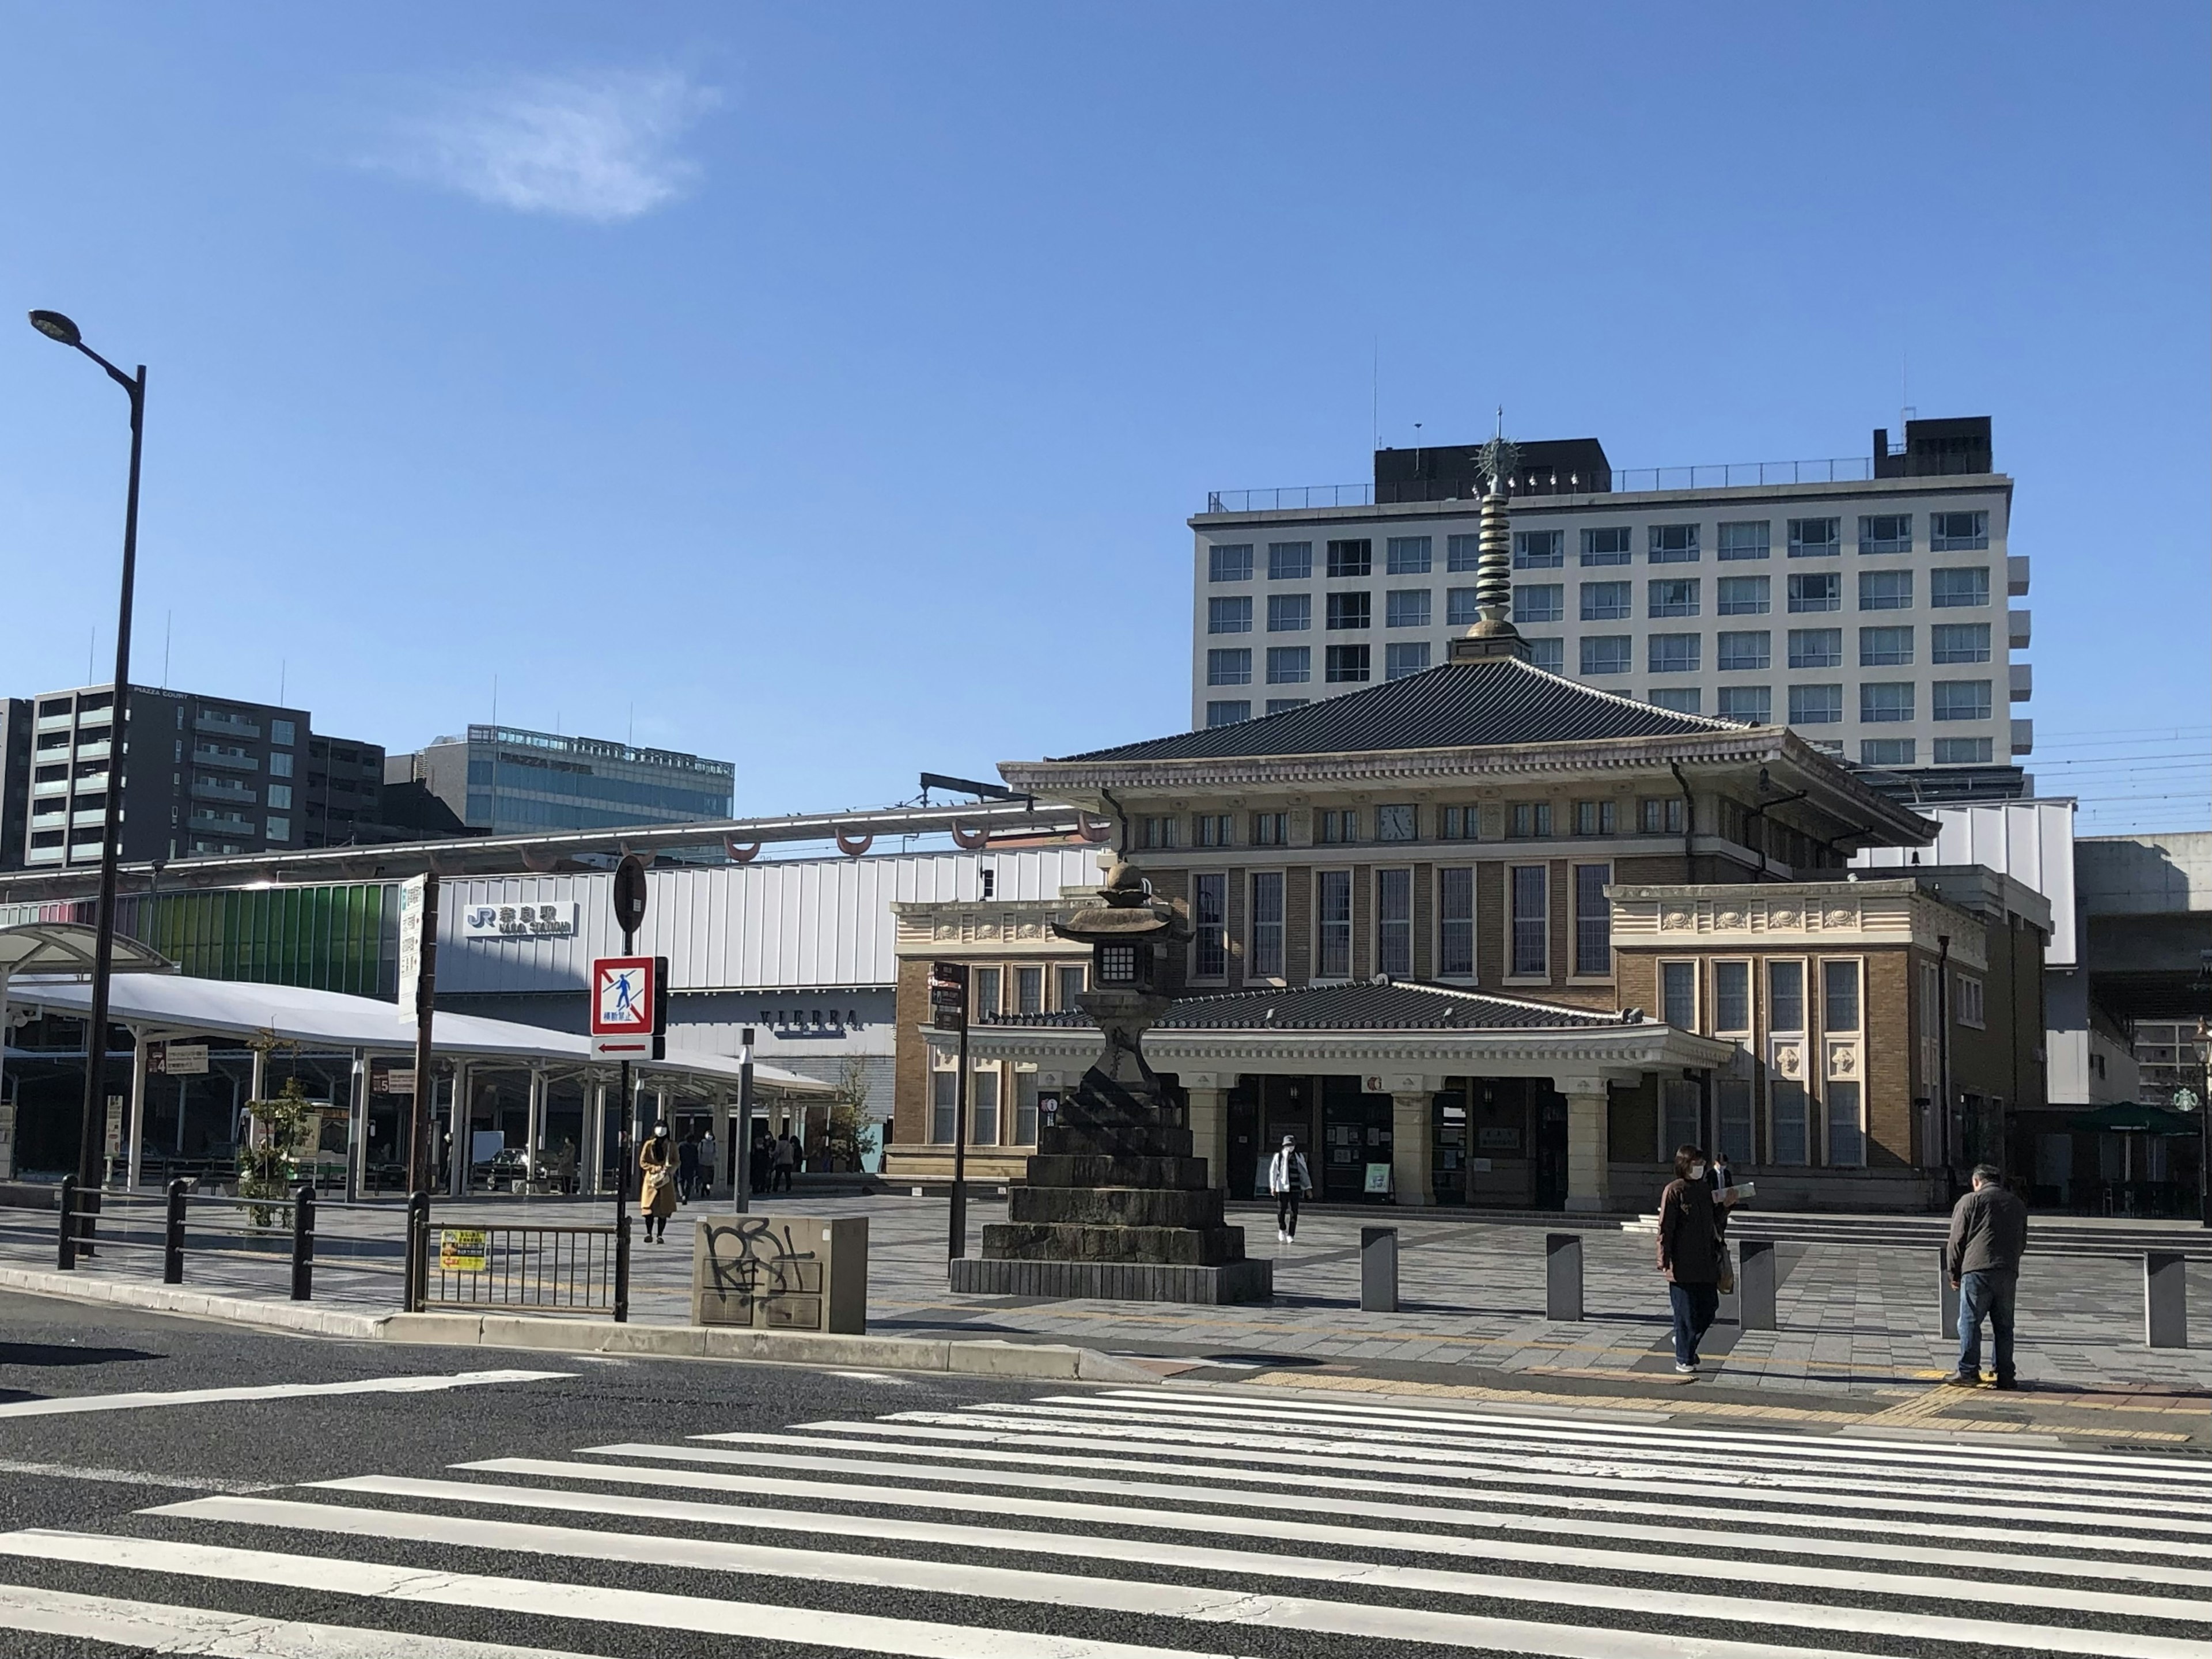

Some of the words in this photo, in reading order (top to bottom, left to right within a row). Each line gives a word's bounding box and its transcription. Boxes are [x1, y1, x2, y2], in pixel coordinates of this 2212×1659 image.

[134, 686, 160, 696] PIAZZA
[162, 691, 188, 699] COURT
[468, 907, 495, 928] JR
[760, 1010, 857, 1027] VIERRA
[157, 1059, 165, 1072] 4
[381, 1080, 389, 1092] 5
